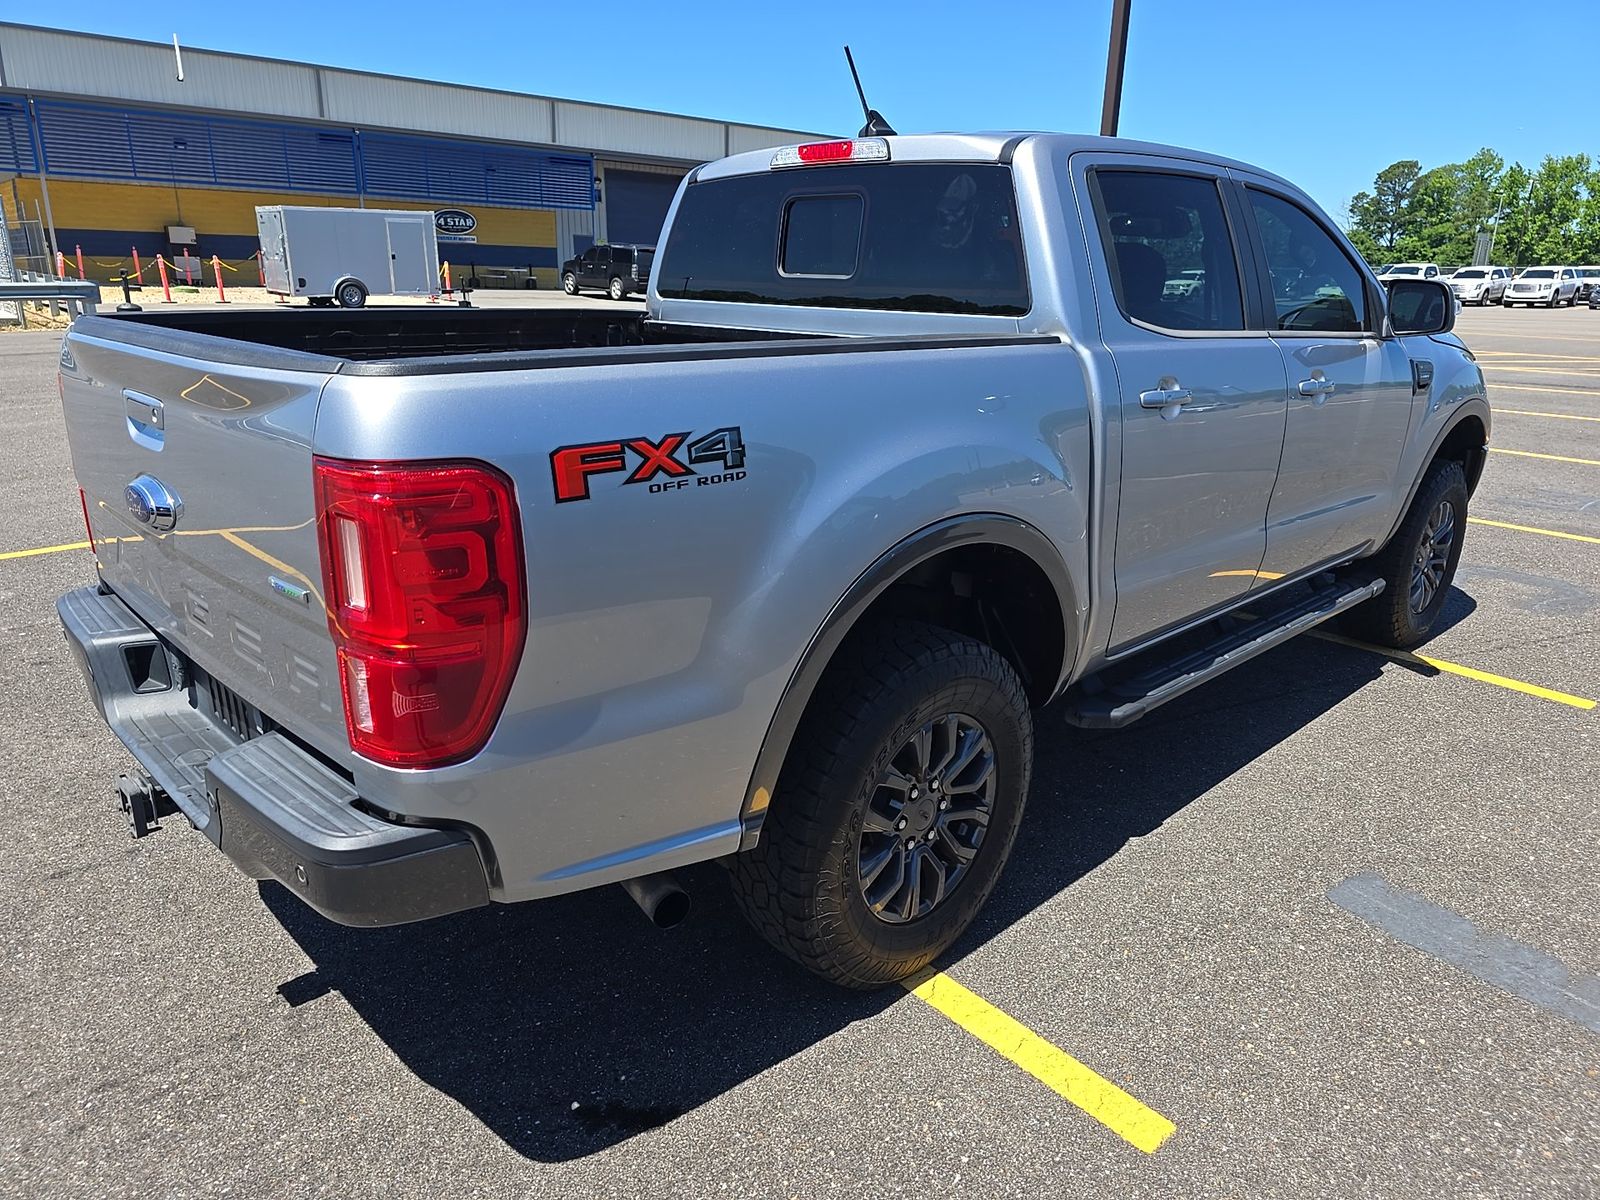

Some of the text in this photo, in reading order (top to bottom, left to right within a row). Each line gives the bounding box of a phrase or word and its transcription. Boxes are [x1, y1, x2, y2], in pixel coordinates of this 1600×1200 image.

[438, 217, 473, 226] 4 STAR
[549, 426, 746, 504] FX4
[649, 471, 747, 494] OFF ROAD
